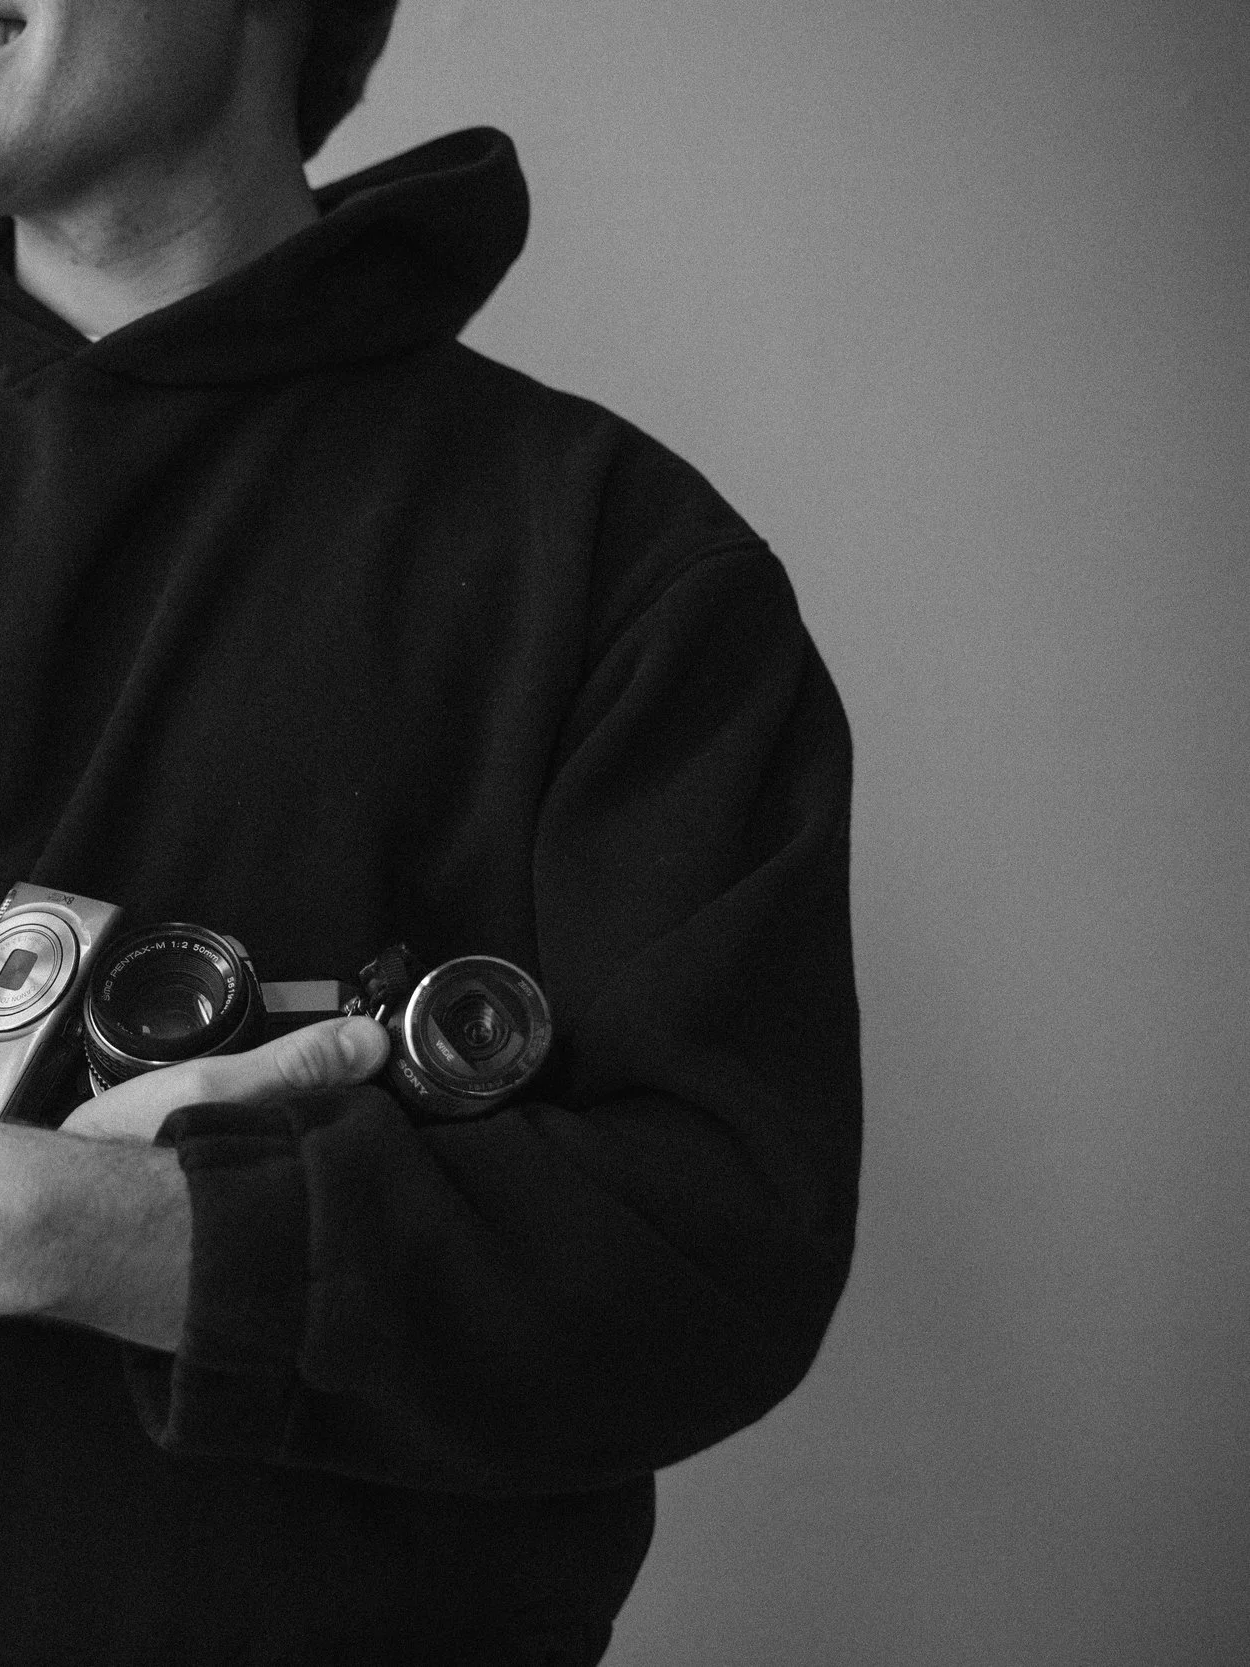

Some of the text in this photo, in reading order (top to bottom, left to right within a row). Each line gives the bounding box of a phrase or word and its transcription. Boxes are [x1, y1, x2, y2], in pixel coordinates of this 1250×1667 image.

[110, 941, 166, 979] PENTAX-M
[171, 941, 189, 949] 1:2
[192, 943, 220, 963] 50mm
[435, 1039, 455, 1062] WIDE
[397, 1058, 429, 1095] SONY
